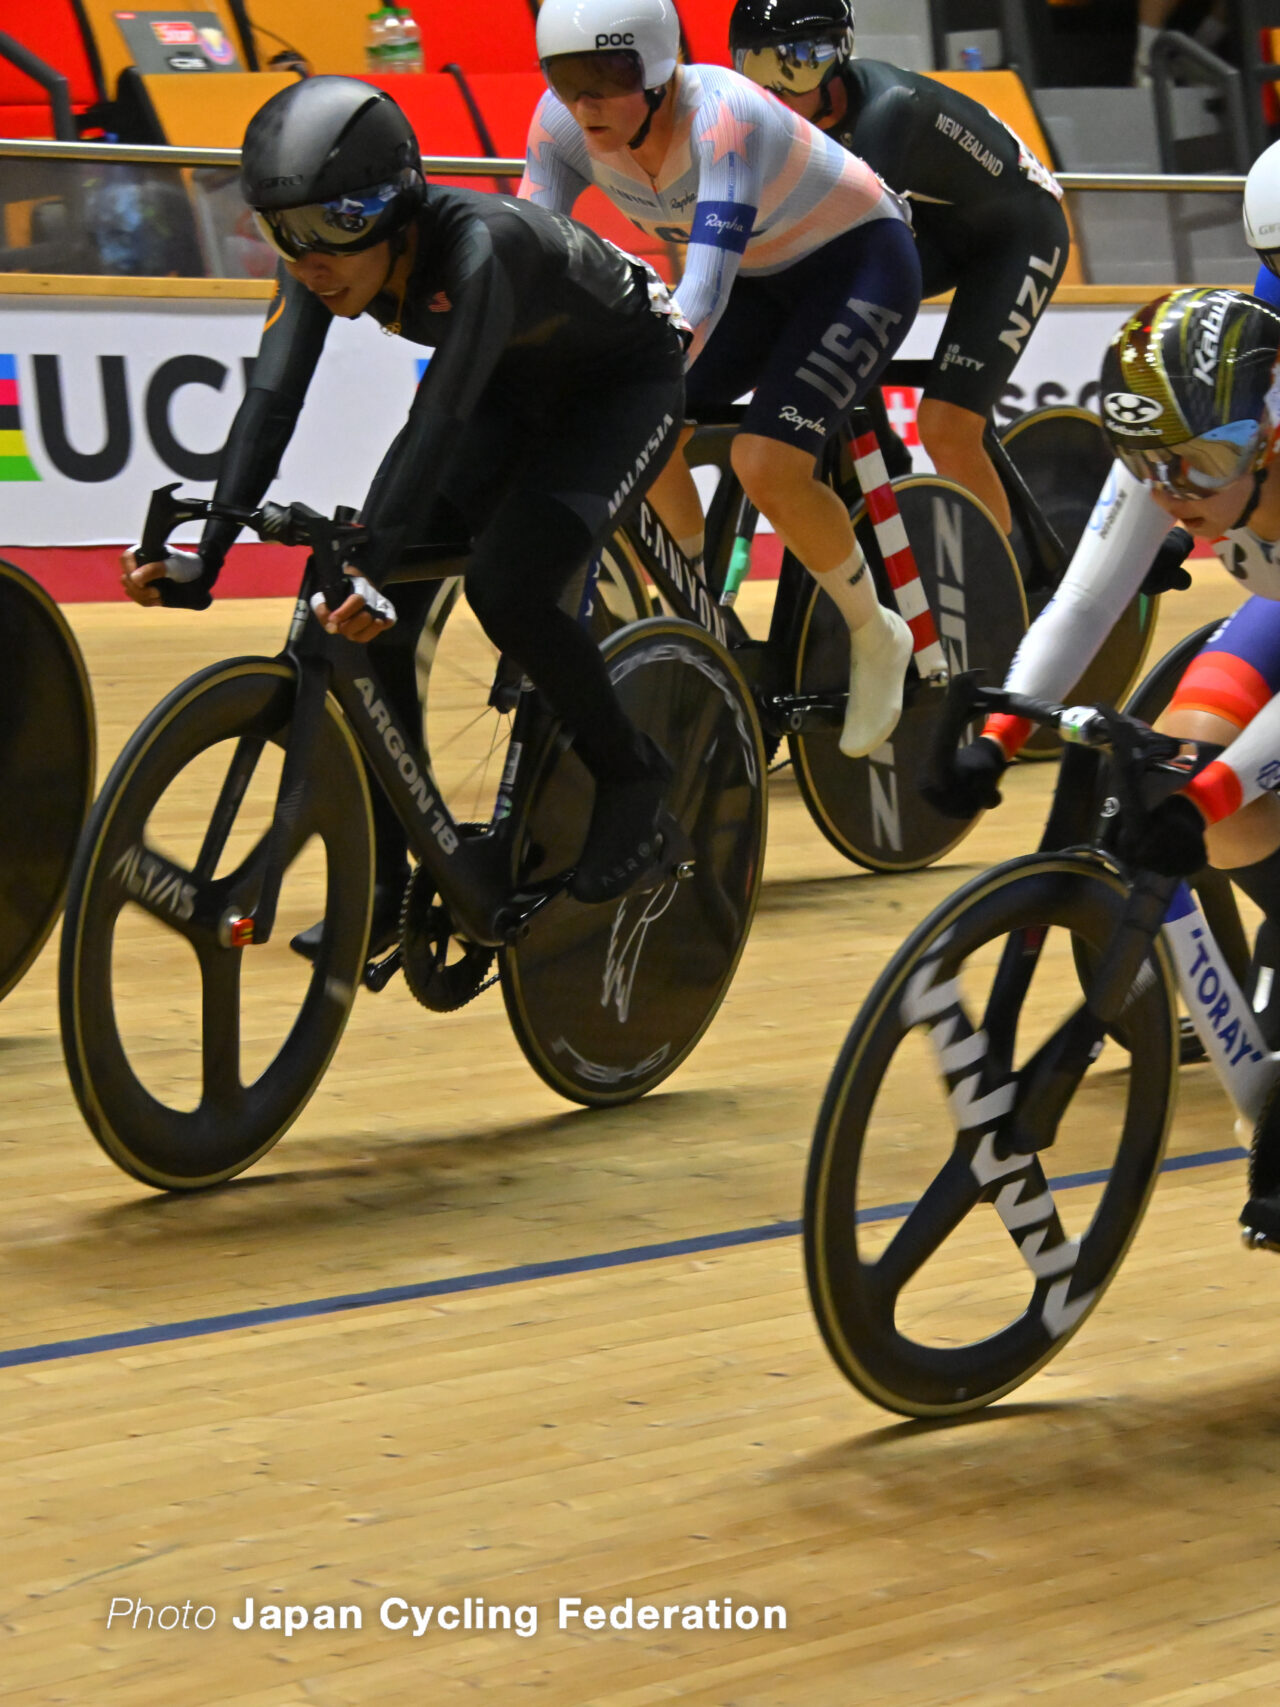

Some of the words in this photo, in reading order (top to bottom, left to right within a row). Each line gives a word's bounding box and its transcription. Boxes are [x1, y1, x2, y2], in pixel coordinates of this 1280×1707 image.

[935, 113, 960, 142] NEW
[958, 129, 1004, 178] ZEALAND
[705, 213, 745, 235] Rapha
[998, 246, 1061, 355] NZL
[795, 297, 903, 410] USA
[608, 413, 674, 518] MALAYSIA
[778, 405, 827, 436] Rapha
[353, 677, 434, 814] ARGON
[430, 810, 460, 855] 18
